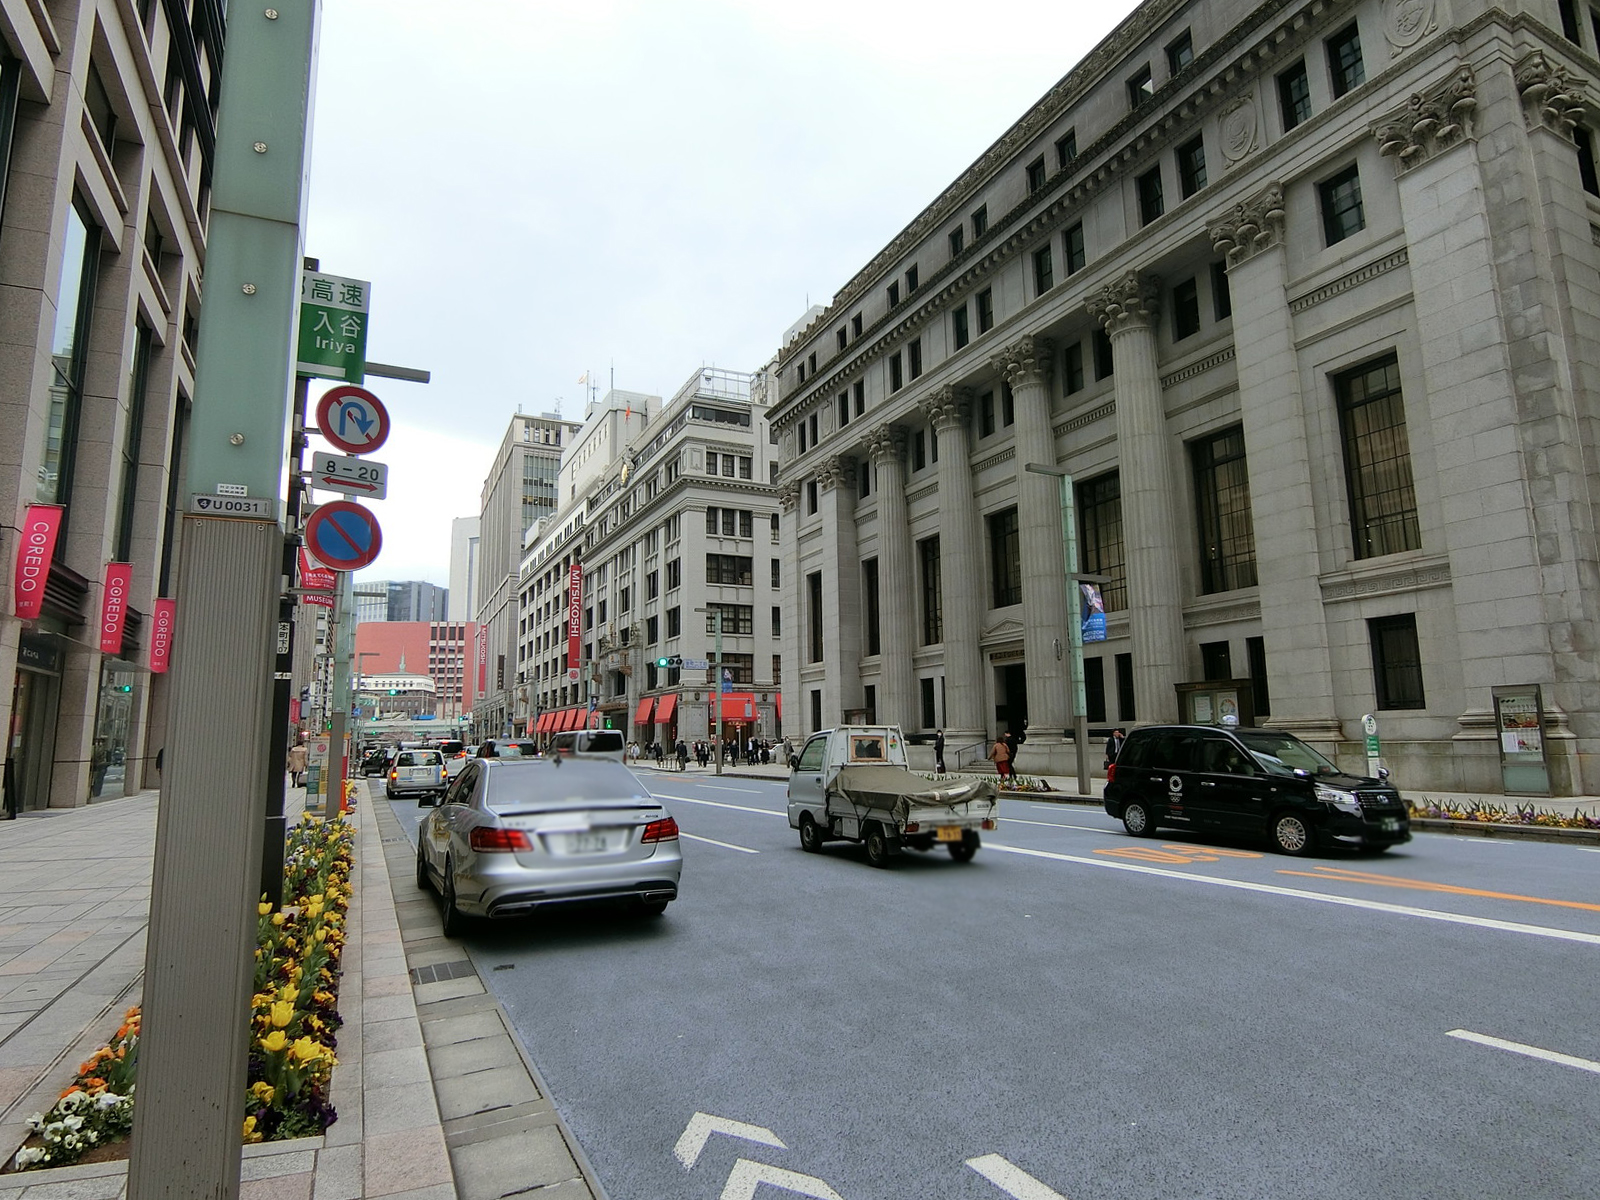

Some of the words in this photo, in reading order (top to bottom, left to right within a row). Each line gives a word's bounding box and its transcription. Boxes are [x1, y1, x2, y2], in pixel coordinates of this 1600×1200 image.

[302, 276, 363, 307] 高速
[313, 311, 361, 339] 入谷
[316, 335, 355, 353] Iriya
[21, 522, 49, 592] COREDO
[105, 577, 123, 633] COREDO
[306, 595, 333, 604] MUSEUM
[570, 569, 580, 637] MITSUKOSHI
[155, 610, 169, 657] COREDO
